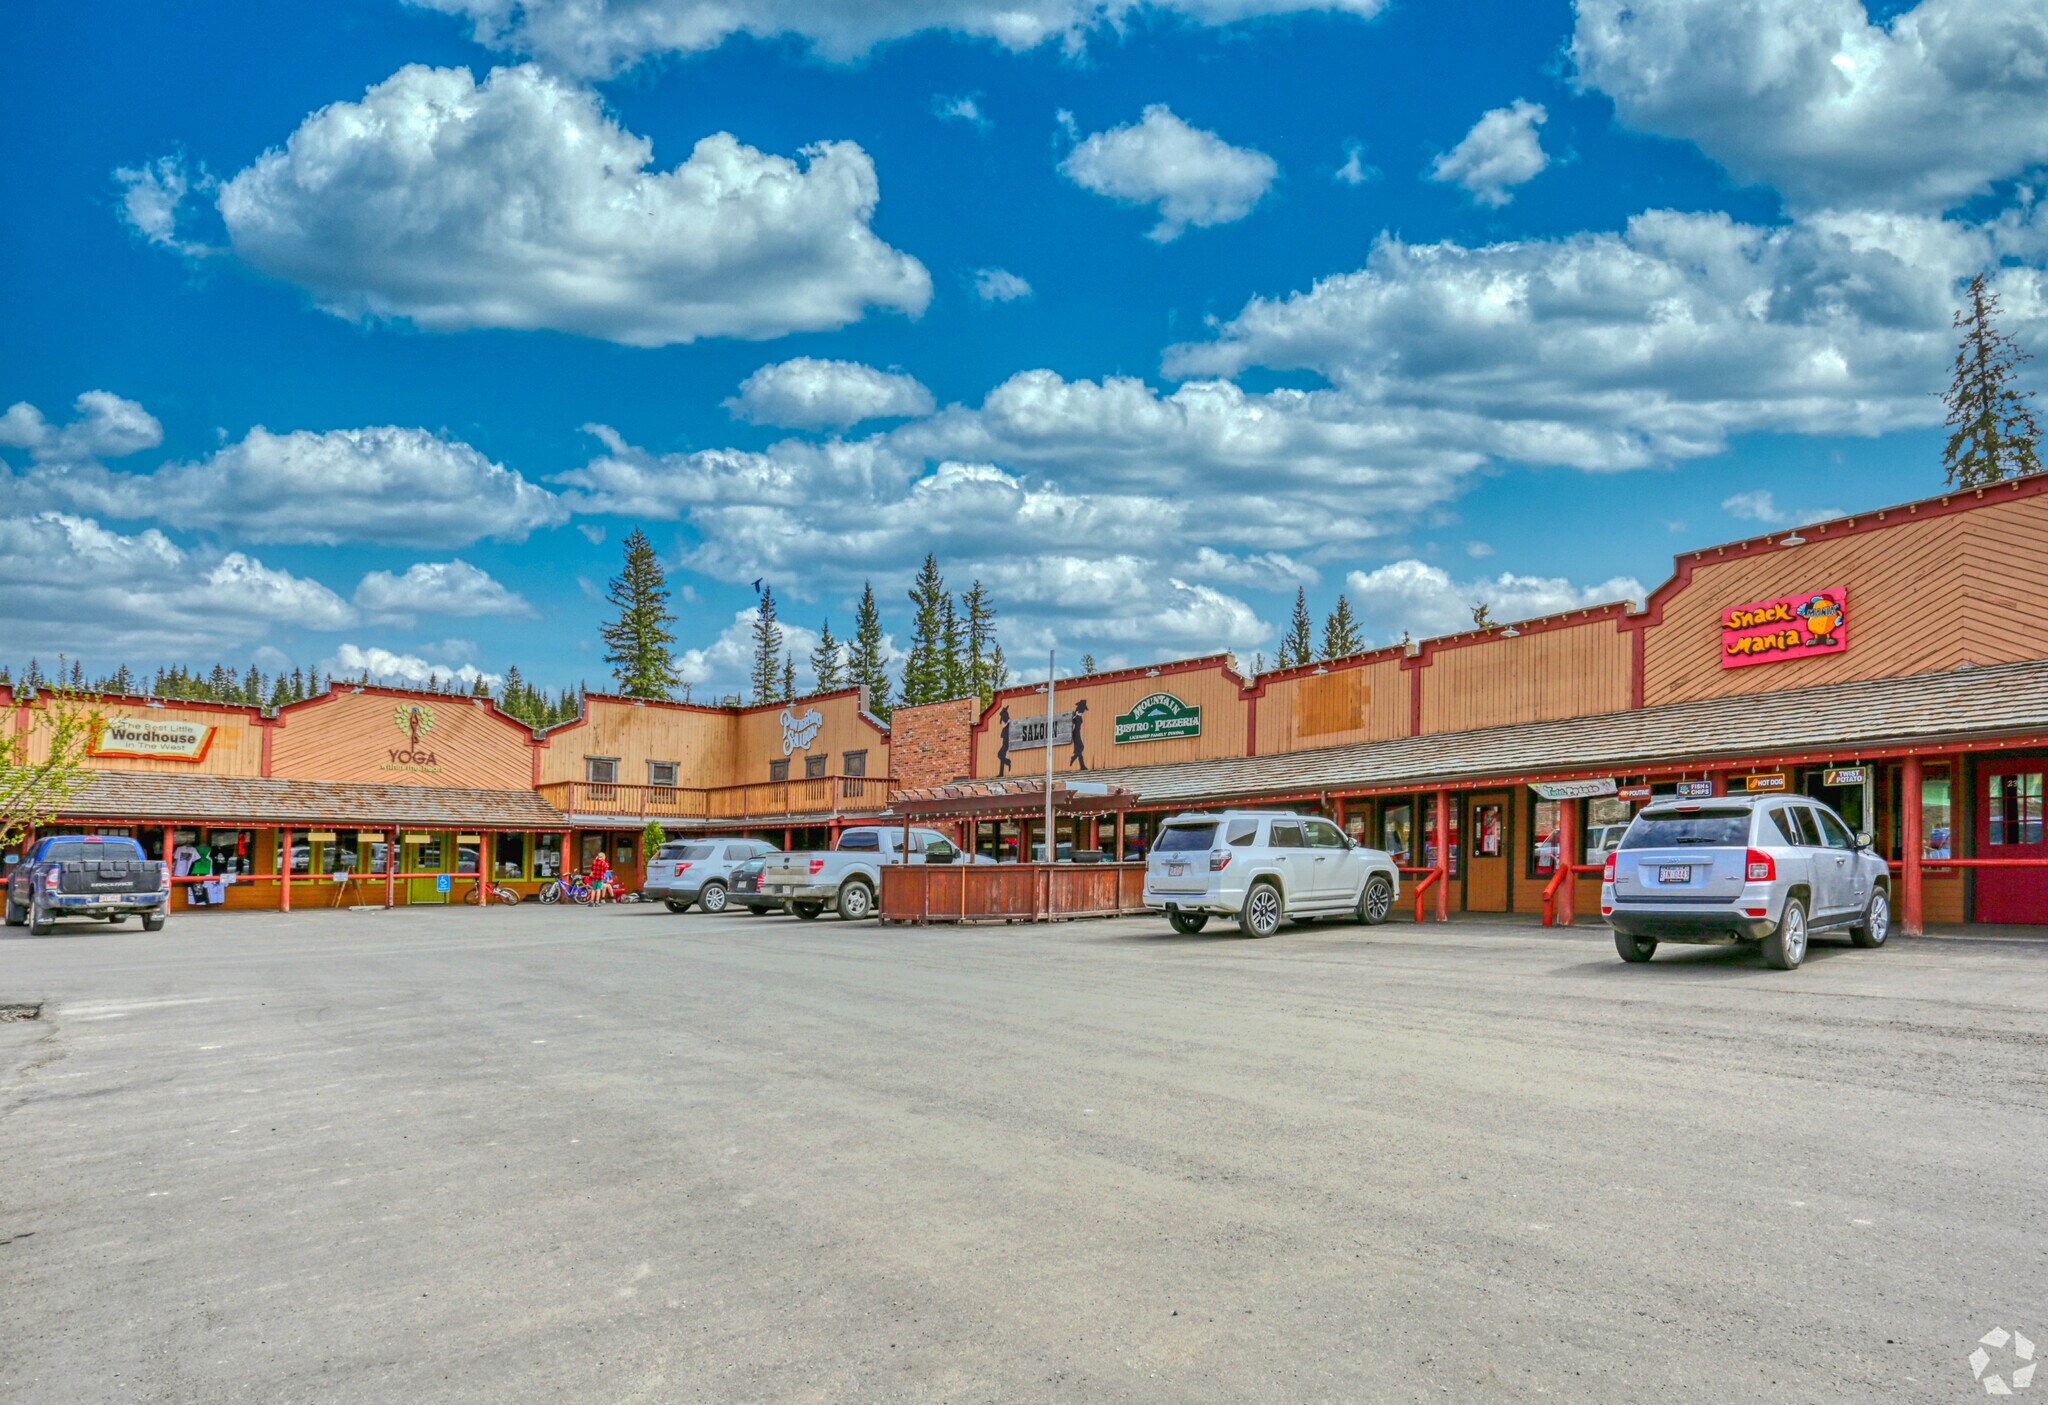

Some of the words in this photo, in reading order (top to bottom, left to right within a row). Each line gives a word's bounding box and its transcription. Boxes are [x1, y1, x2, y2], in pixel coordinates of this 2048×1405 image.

[1722, 602, 1796, 630] Snack
[1726, 629, 1803, 656] Mania
[1132, 694, 1181, 720] MOUNTAIN
[121, 721, 142, 730] The
[144, 723, 167, 732] Best
[170, 724, 194, 733] Little
[1115, 722, 1149, 736] BISTRO
[1155, 716, 1200, 732] PIZZERIA
[111, 728, 197, 744] Wordhouse
[160, 743, 185, 751] West
[388, 749, 438, 766] YOGA
[1838, 769, 1860, 777] TWIST
[1757, 779, 1770, 787] HOT
[1629, 789, 1650, 797] POUTINE
